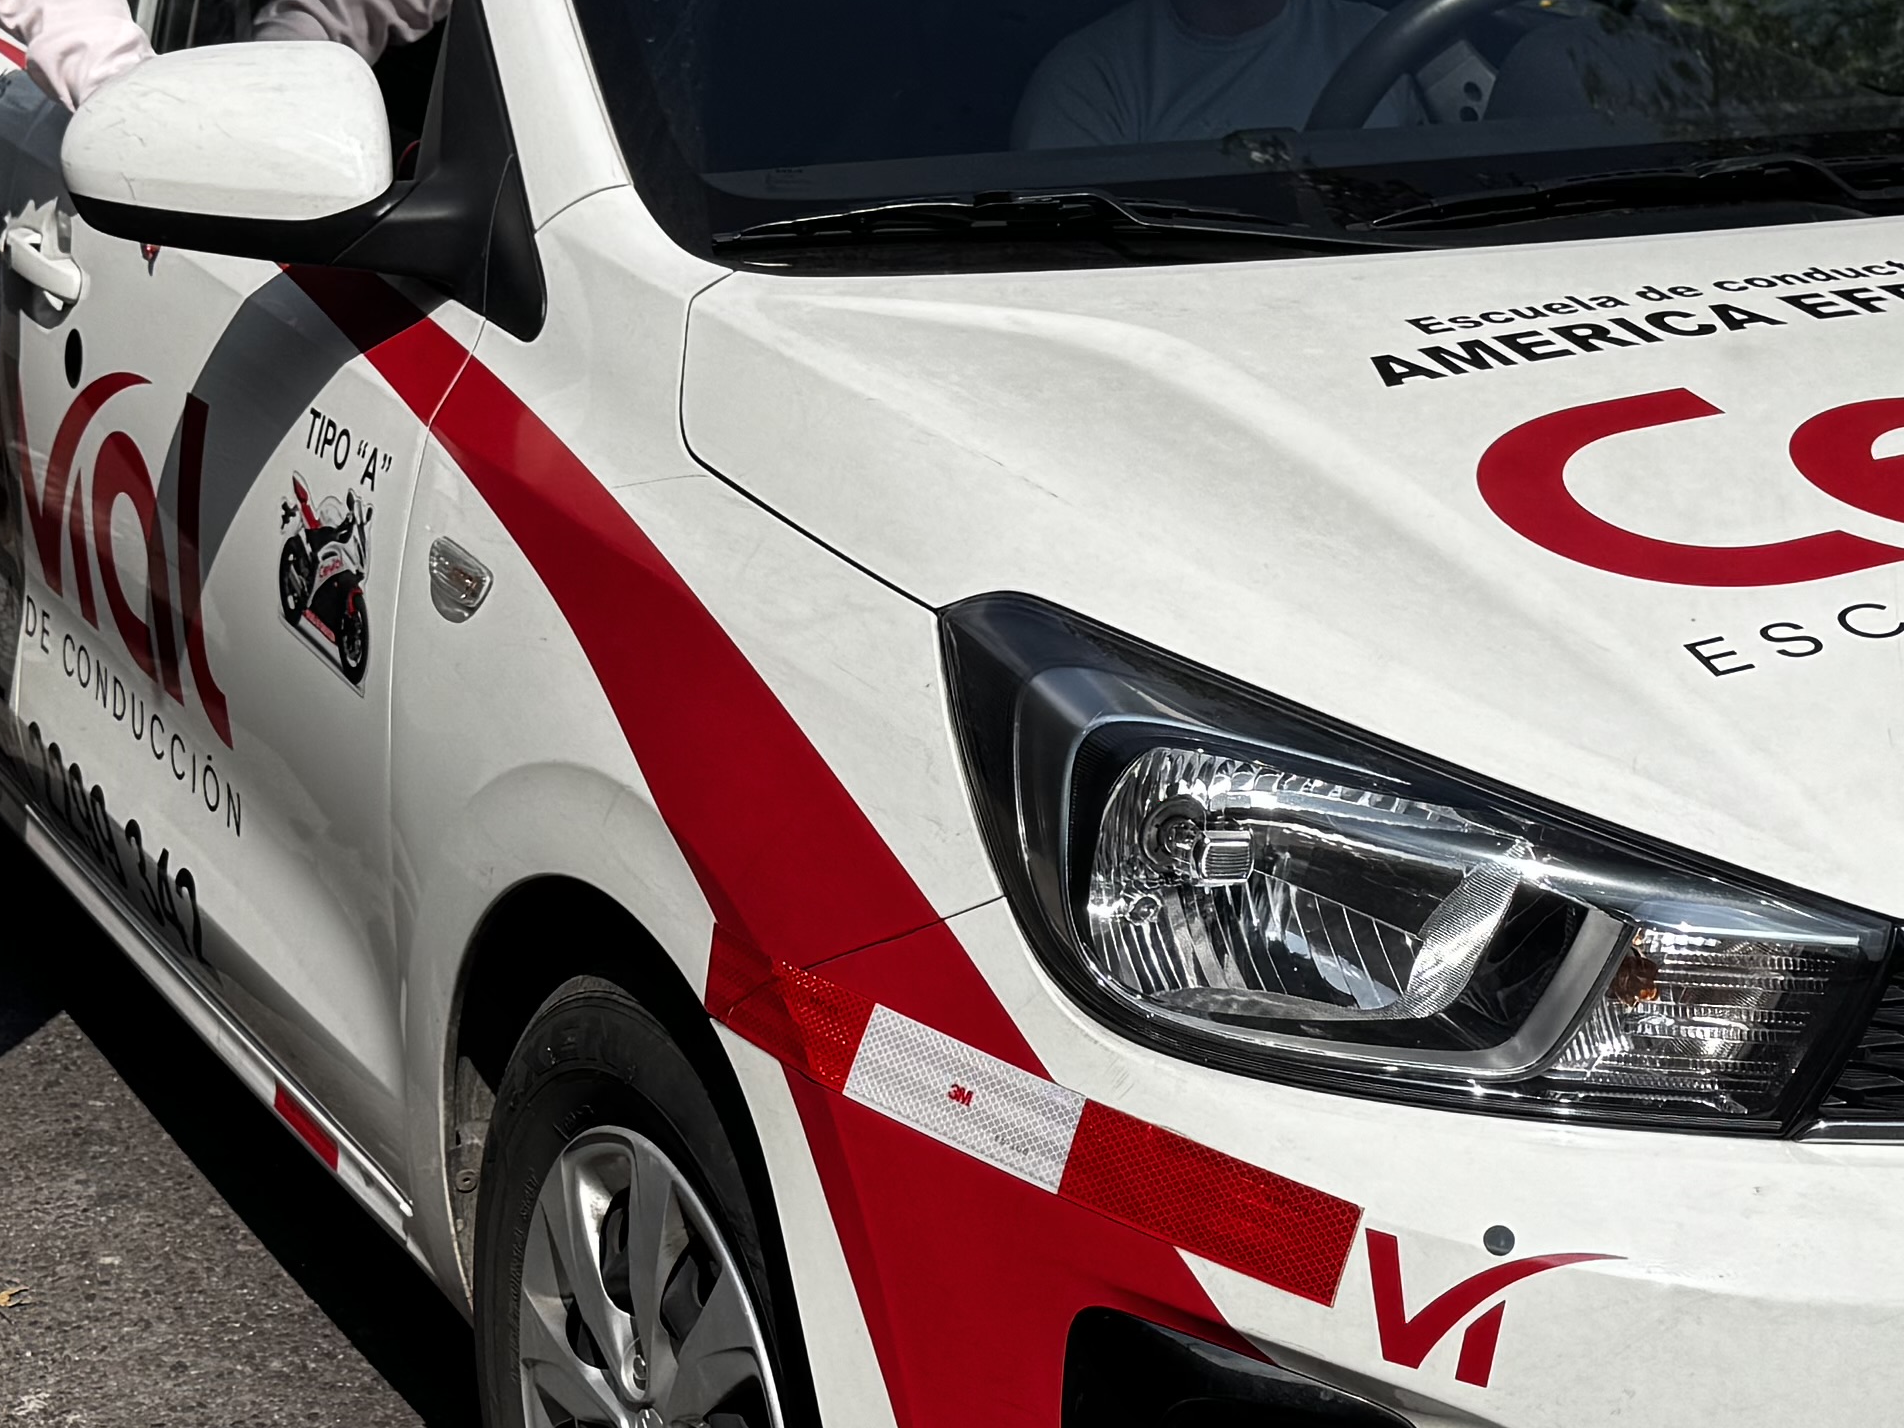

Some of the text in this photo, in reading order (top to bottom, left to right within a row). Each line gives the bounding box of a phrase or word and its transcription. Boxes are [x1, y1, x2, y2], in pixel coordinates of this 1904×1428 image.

[1405, 290, 1630, 337] Escuela
[1635, 281, 1705, 303] de
[1370, 301, 1790, 388] AMERICA
[305, 407, 351, 471] TIPO
[25, 594, 51, 655] DE
[62, 630, 242, 838] CONDUCCIÓN
[948, 1083, 974, 1107] 3M
